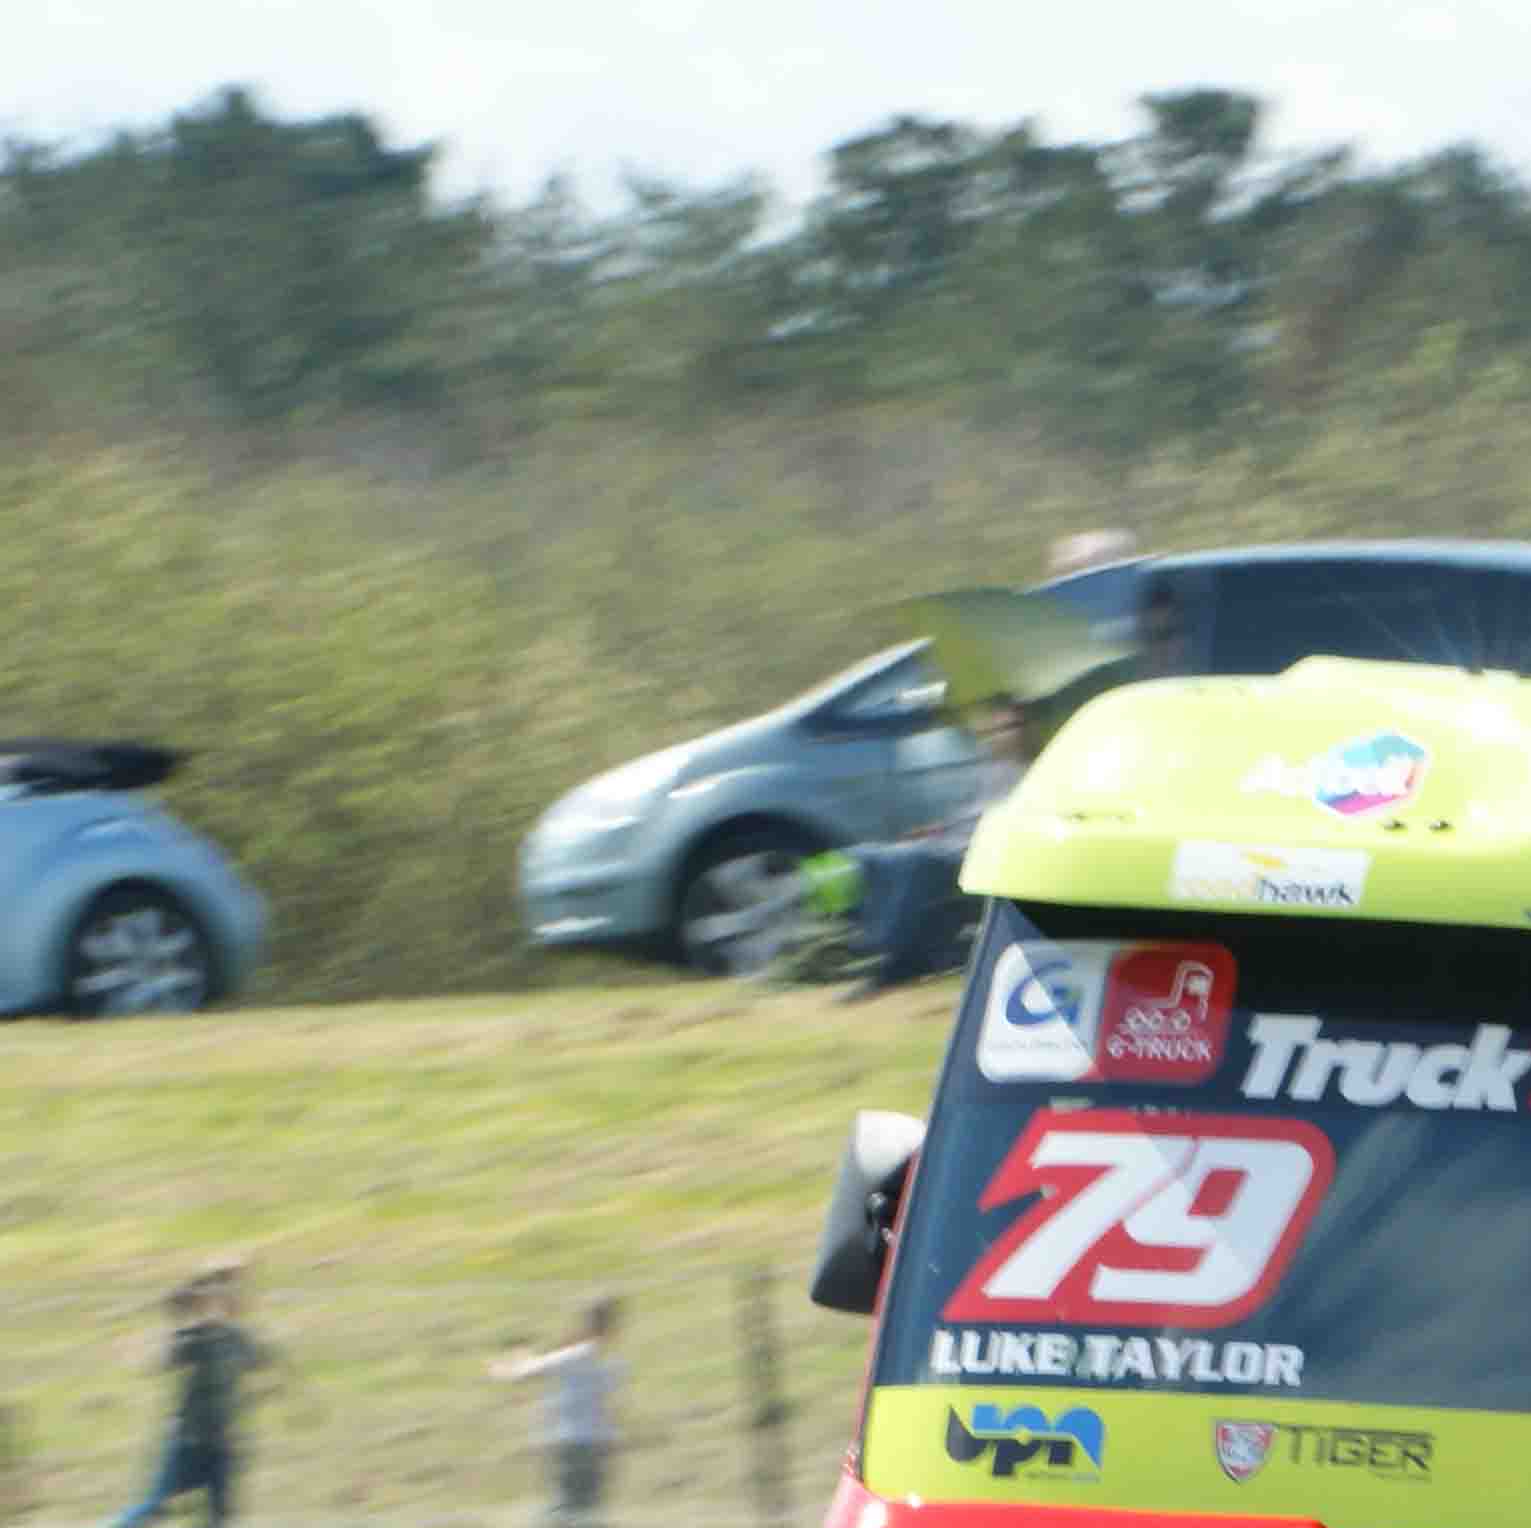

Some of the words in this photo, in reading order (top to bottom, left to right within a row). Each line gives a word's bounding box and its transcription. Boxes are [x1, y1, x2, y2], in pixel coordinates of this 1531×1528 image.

[958, 1114, 1330, 1320] 79
[930, 1329, 1068, 1375] LUKE
[1084, 1334, 1304, 1387] TAYLOR
